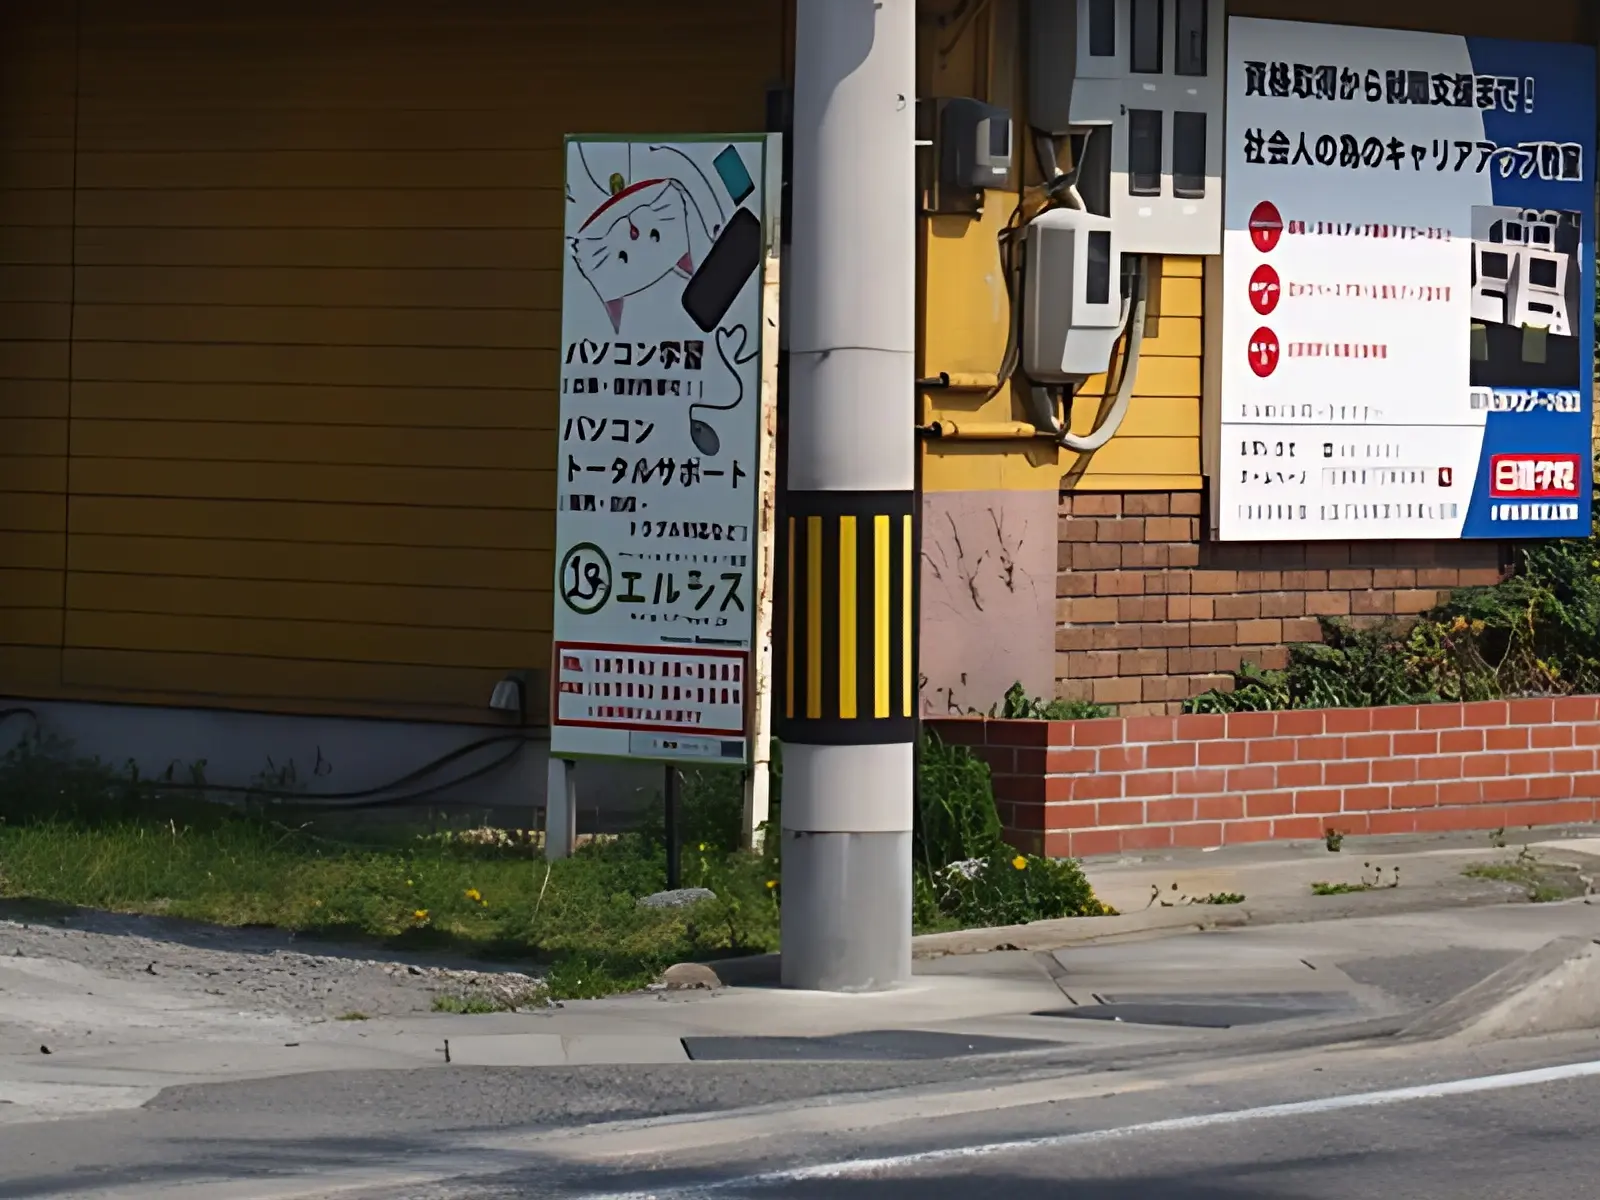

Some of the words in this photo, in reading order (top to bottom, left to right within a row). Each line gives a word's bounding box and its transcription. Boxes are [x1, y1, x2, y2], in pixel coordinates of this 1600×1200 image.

[564, 416, 654, 444] パソコン
[567, 454, 746, 488] トータルサポート
[616, 570, 744, 612] エルシス
